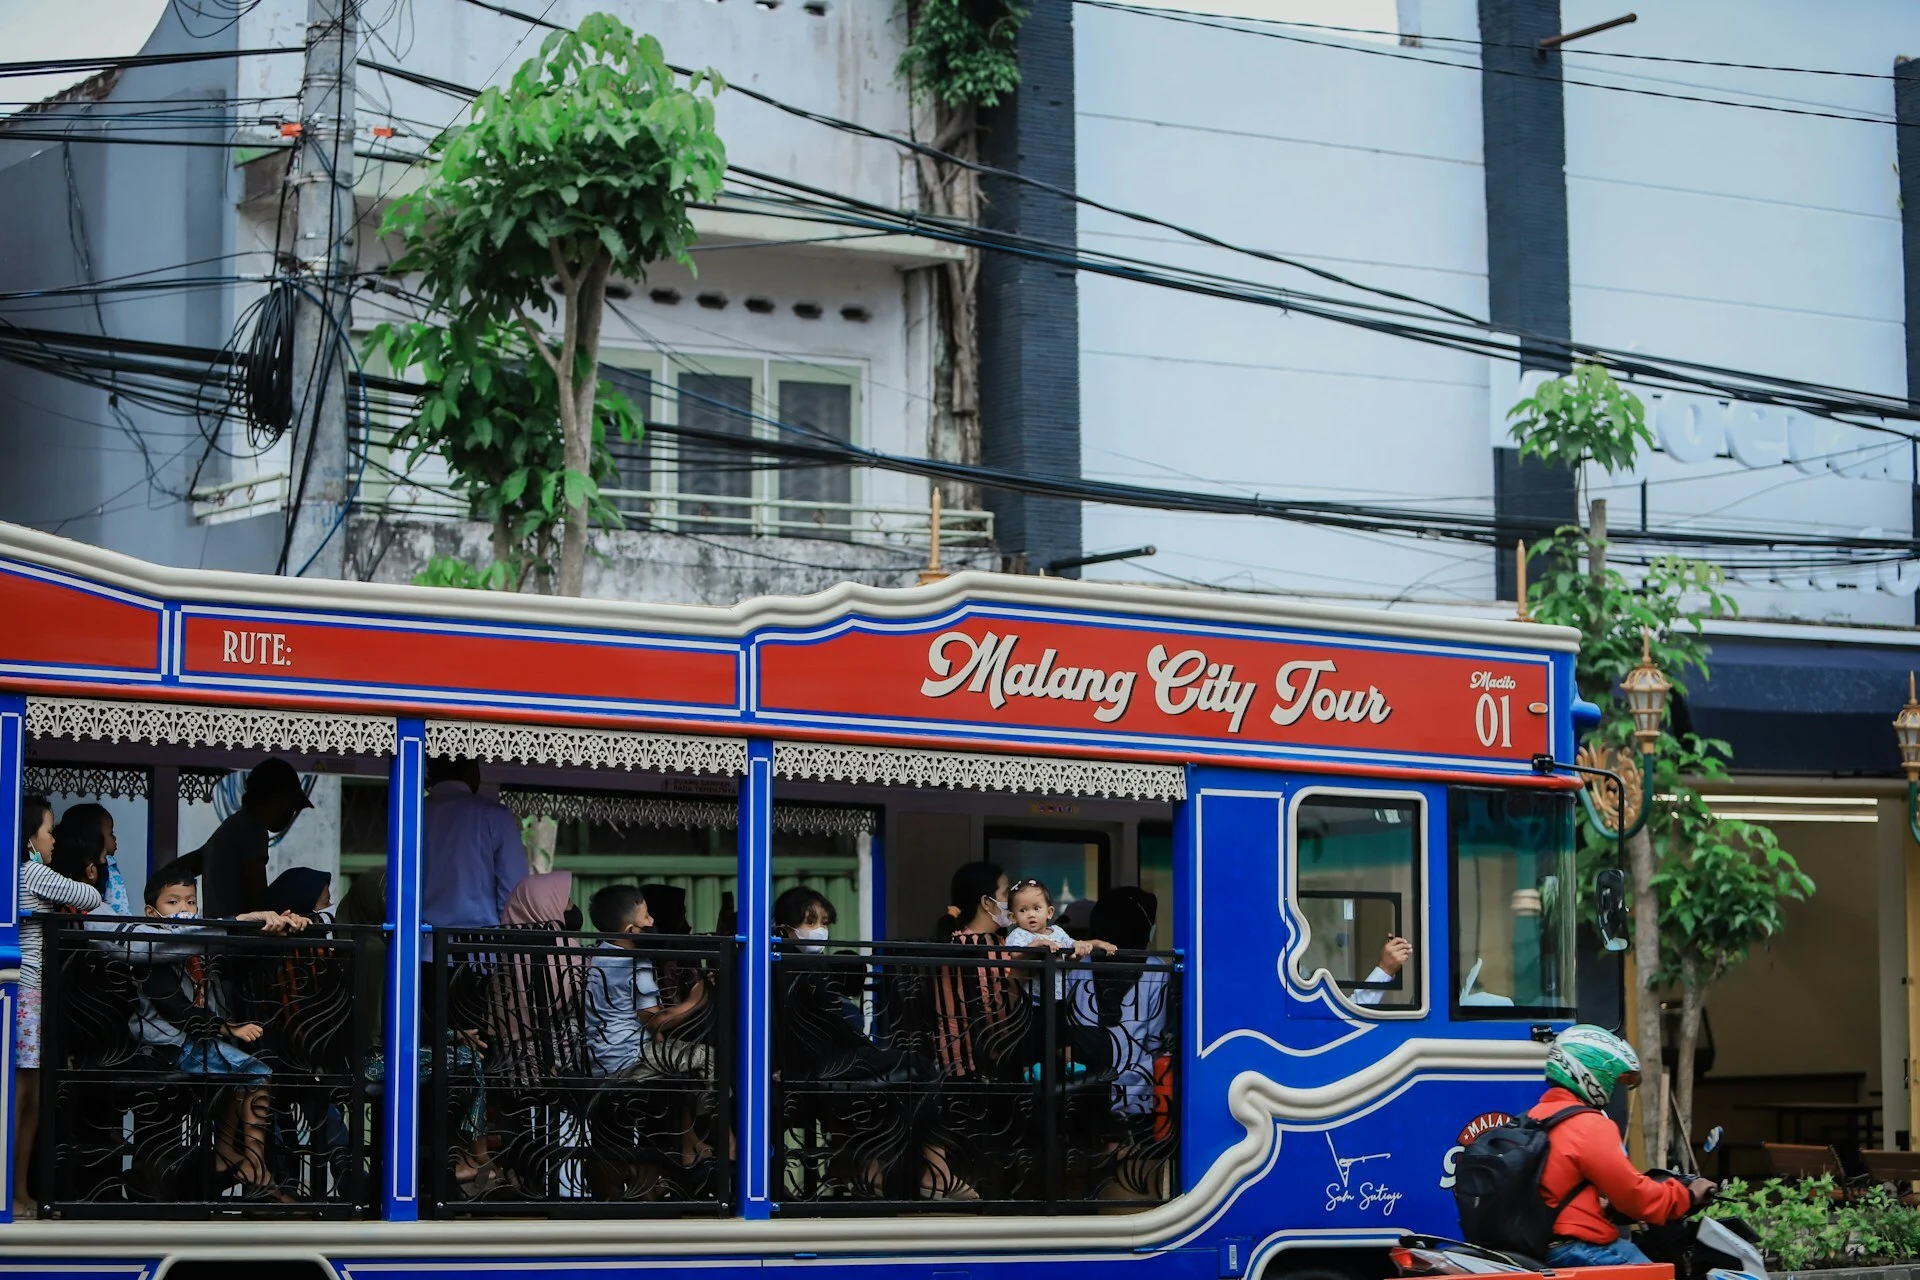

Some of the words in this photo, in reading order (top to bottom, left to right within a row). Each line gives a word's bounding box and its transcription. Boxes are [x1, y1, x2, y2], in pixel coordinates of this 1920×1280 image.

[222, 629, 293, 667] RUTE:
[921, 632, 1137, 721] Malang
[1146, 644, 1255, 733] City
[1269, 659, 1391, 726] Tour
[1469, 670, 1516, 691] Macito
[1475, 694, 1512, 748] 01
[1466, 1114, 1512, 1138] MALA
